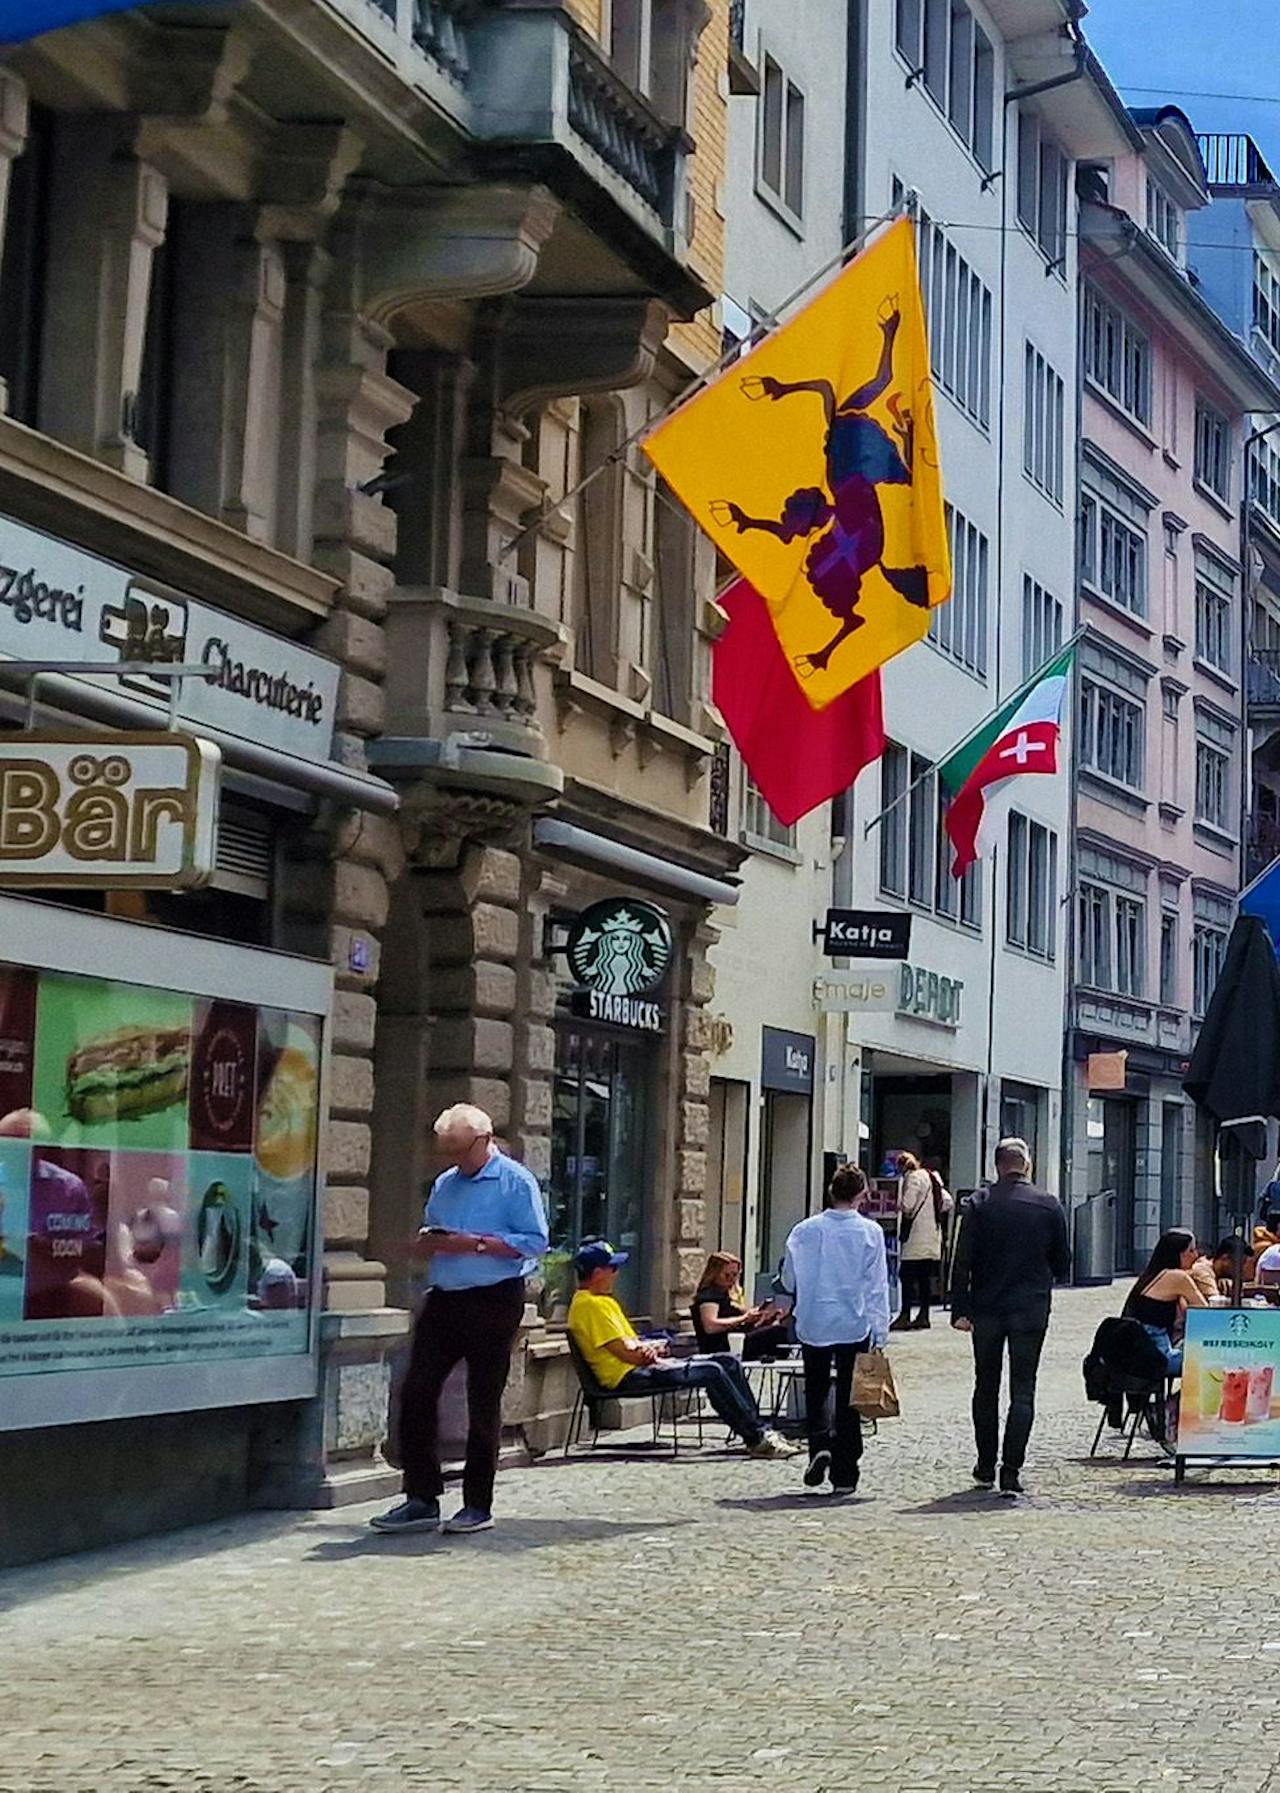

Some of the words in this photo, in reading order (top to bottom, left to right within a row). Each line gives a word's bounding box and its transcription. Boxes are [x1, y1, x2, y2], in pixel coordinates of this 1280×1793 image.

[202, 636, 323, 726] Charcuterie
[0, 753, 185, 863] Bär
[829, 920, 893, 948] Katja
[589, 988, 660, 1031] STARBUCKS
[825, 977, 886, 1002] maje
[898, 962, 964, 1024] DEPOT
